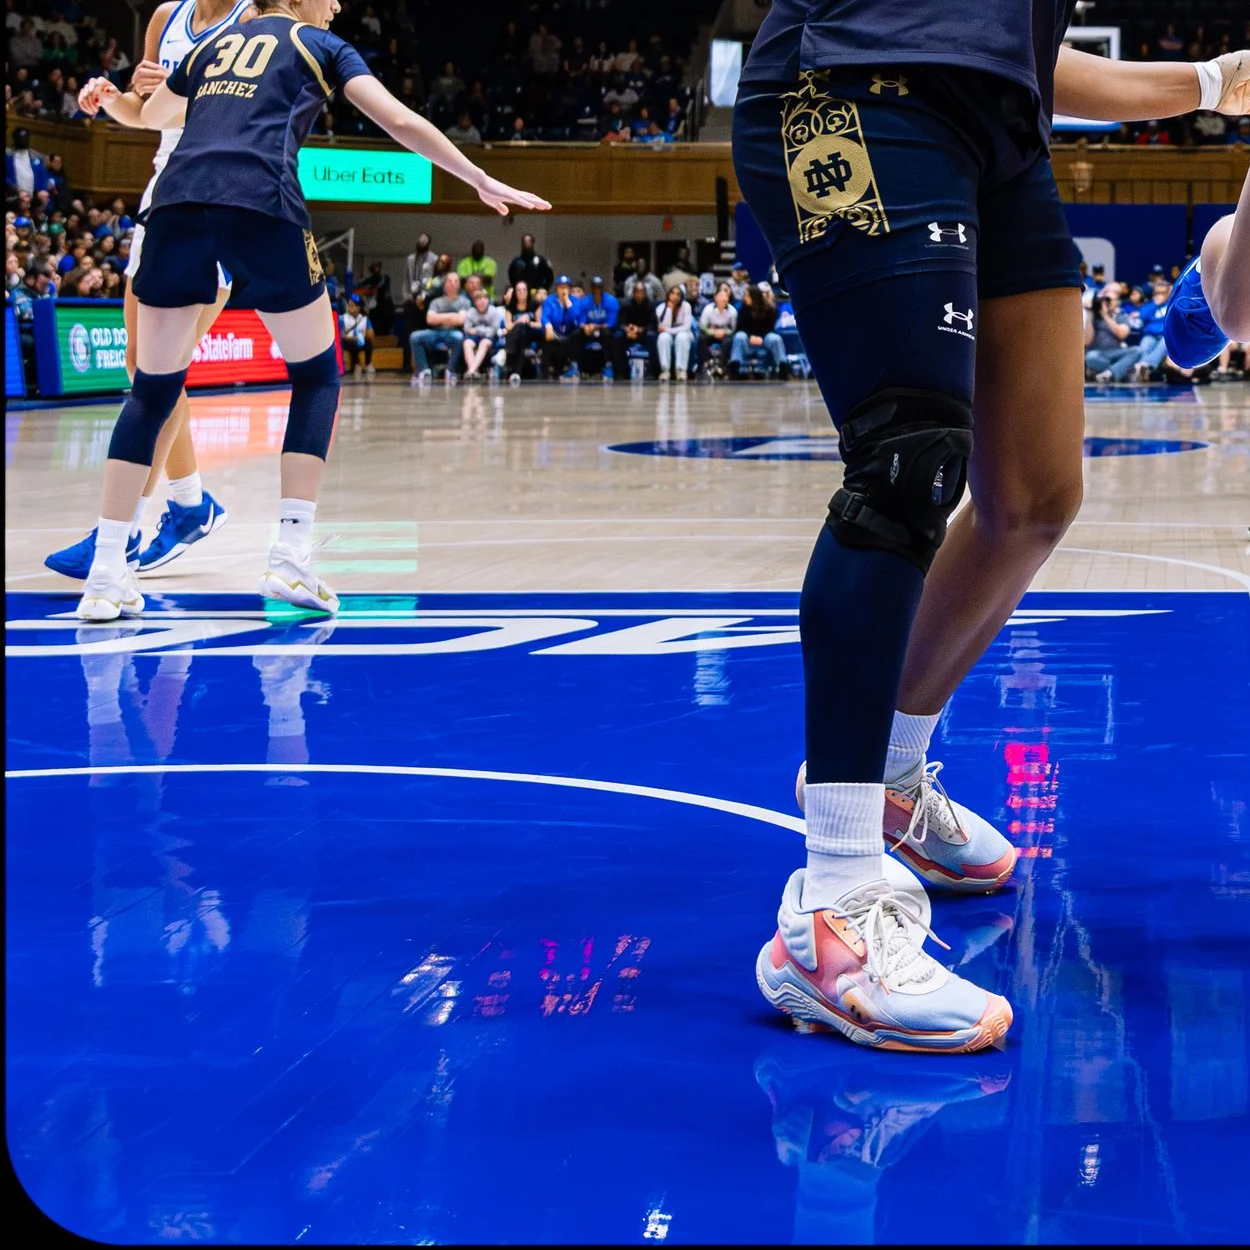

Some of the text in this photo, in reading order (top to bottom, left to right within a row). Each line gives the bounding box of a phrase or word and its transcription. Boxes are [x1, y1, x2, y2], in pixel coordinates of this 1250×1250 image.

[204, 33, 279, 79] 30
[313, 165, 405, 185] Uber Eats
[90, 327, 112, 347] OLD
[96, 348, 127, 369] FREIG
